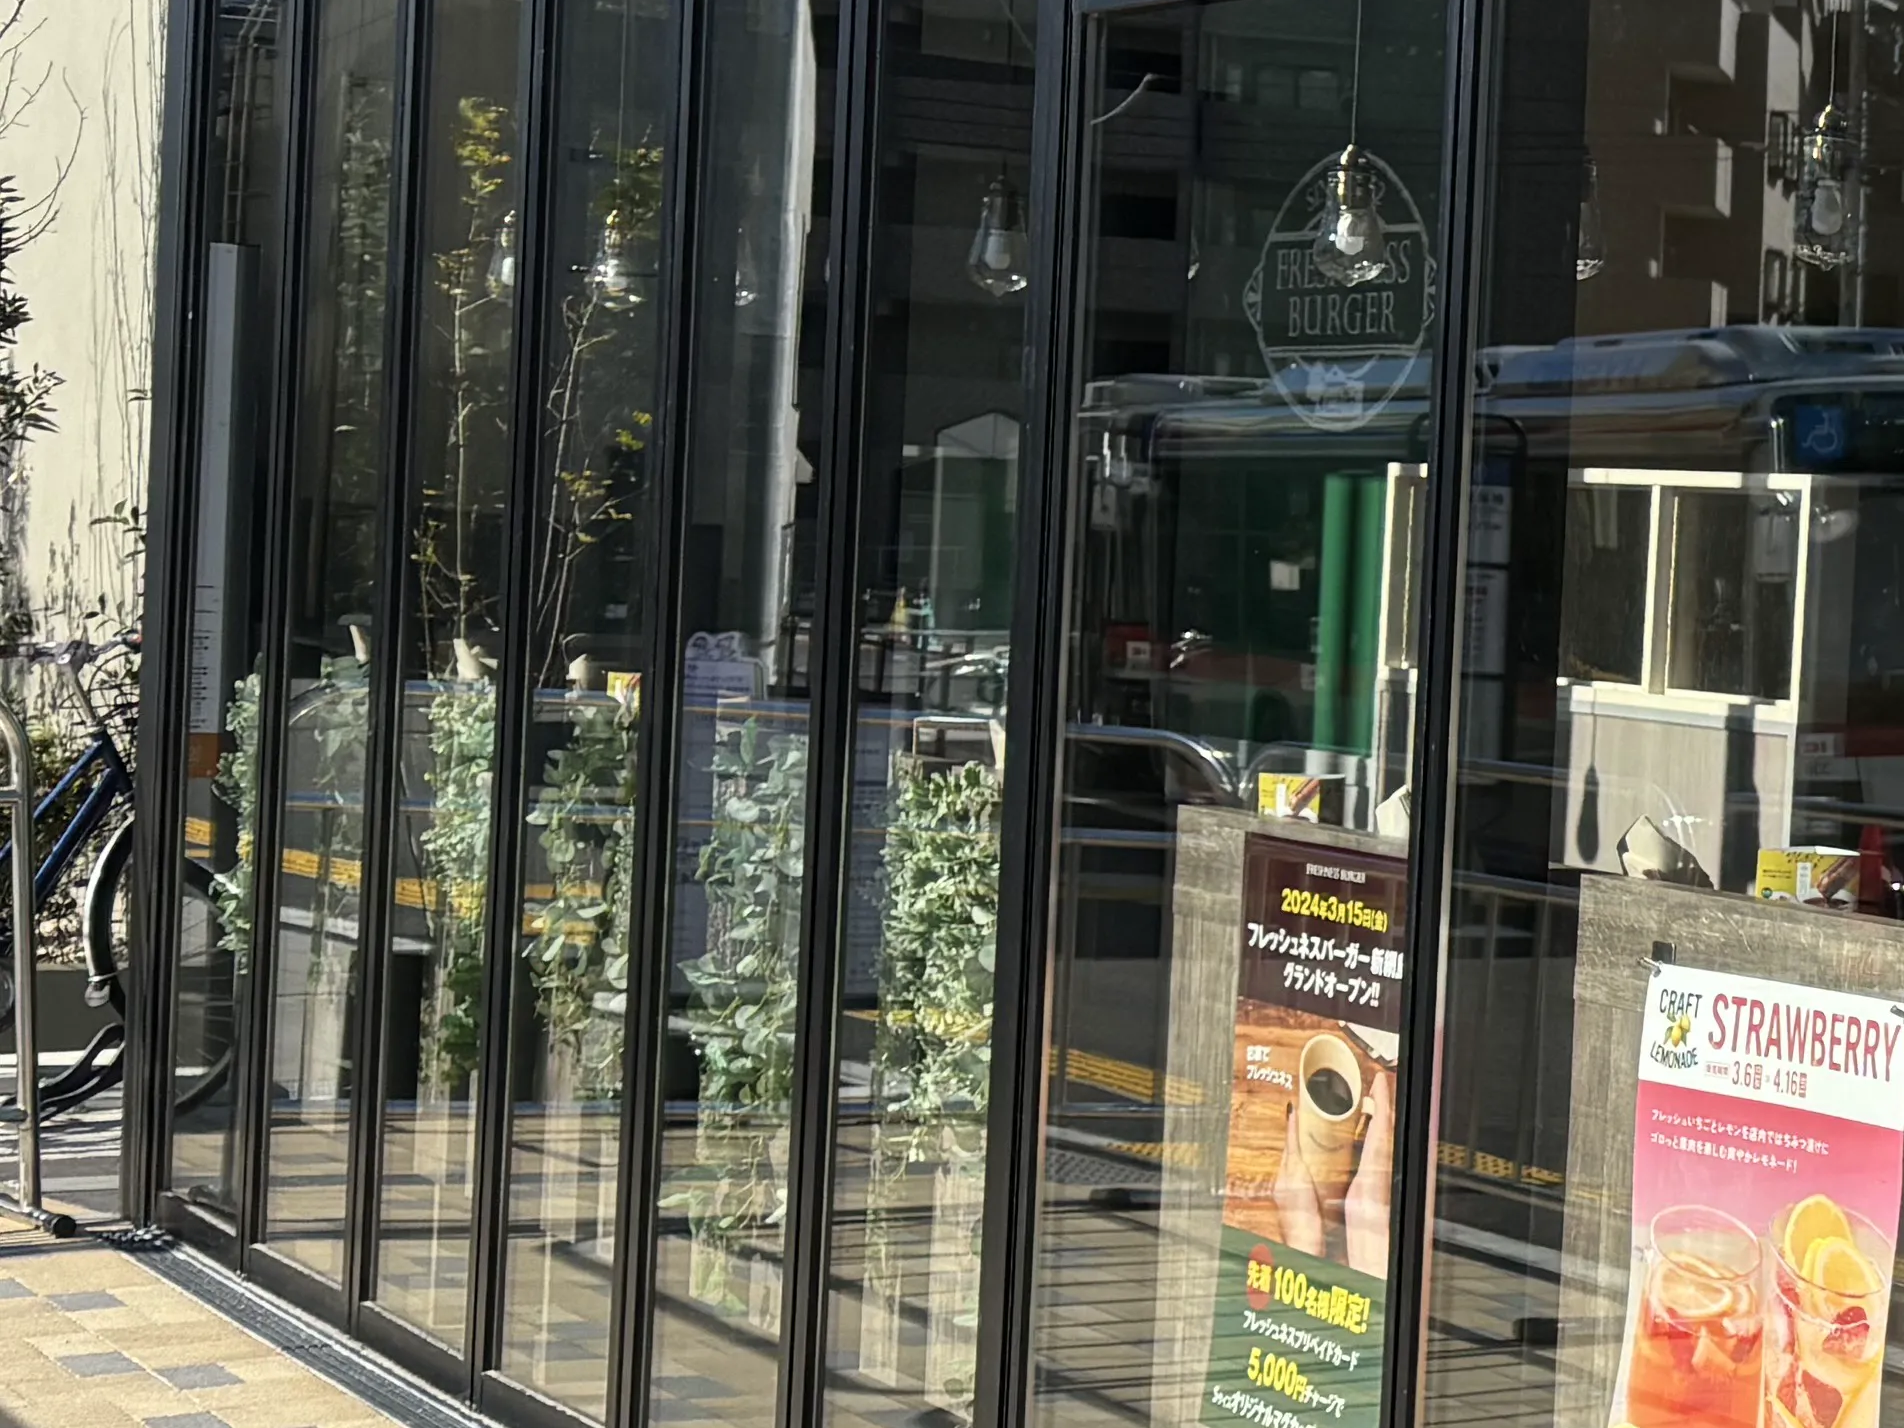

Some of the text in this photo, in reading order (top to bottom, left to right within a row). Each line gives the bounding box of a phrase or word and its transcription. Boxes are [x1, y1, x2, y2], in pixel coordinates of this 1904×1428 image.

[1289, 291, 1396, 337] BURGER
[1659, 988, 1703, 1019] CRAFT
[1650, 1040, 1699, 1070] LEMONADE
[1708, 993, 1901, 1083] STRAWBERRY
